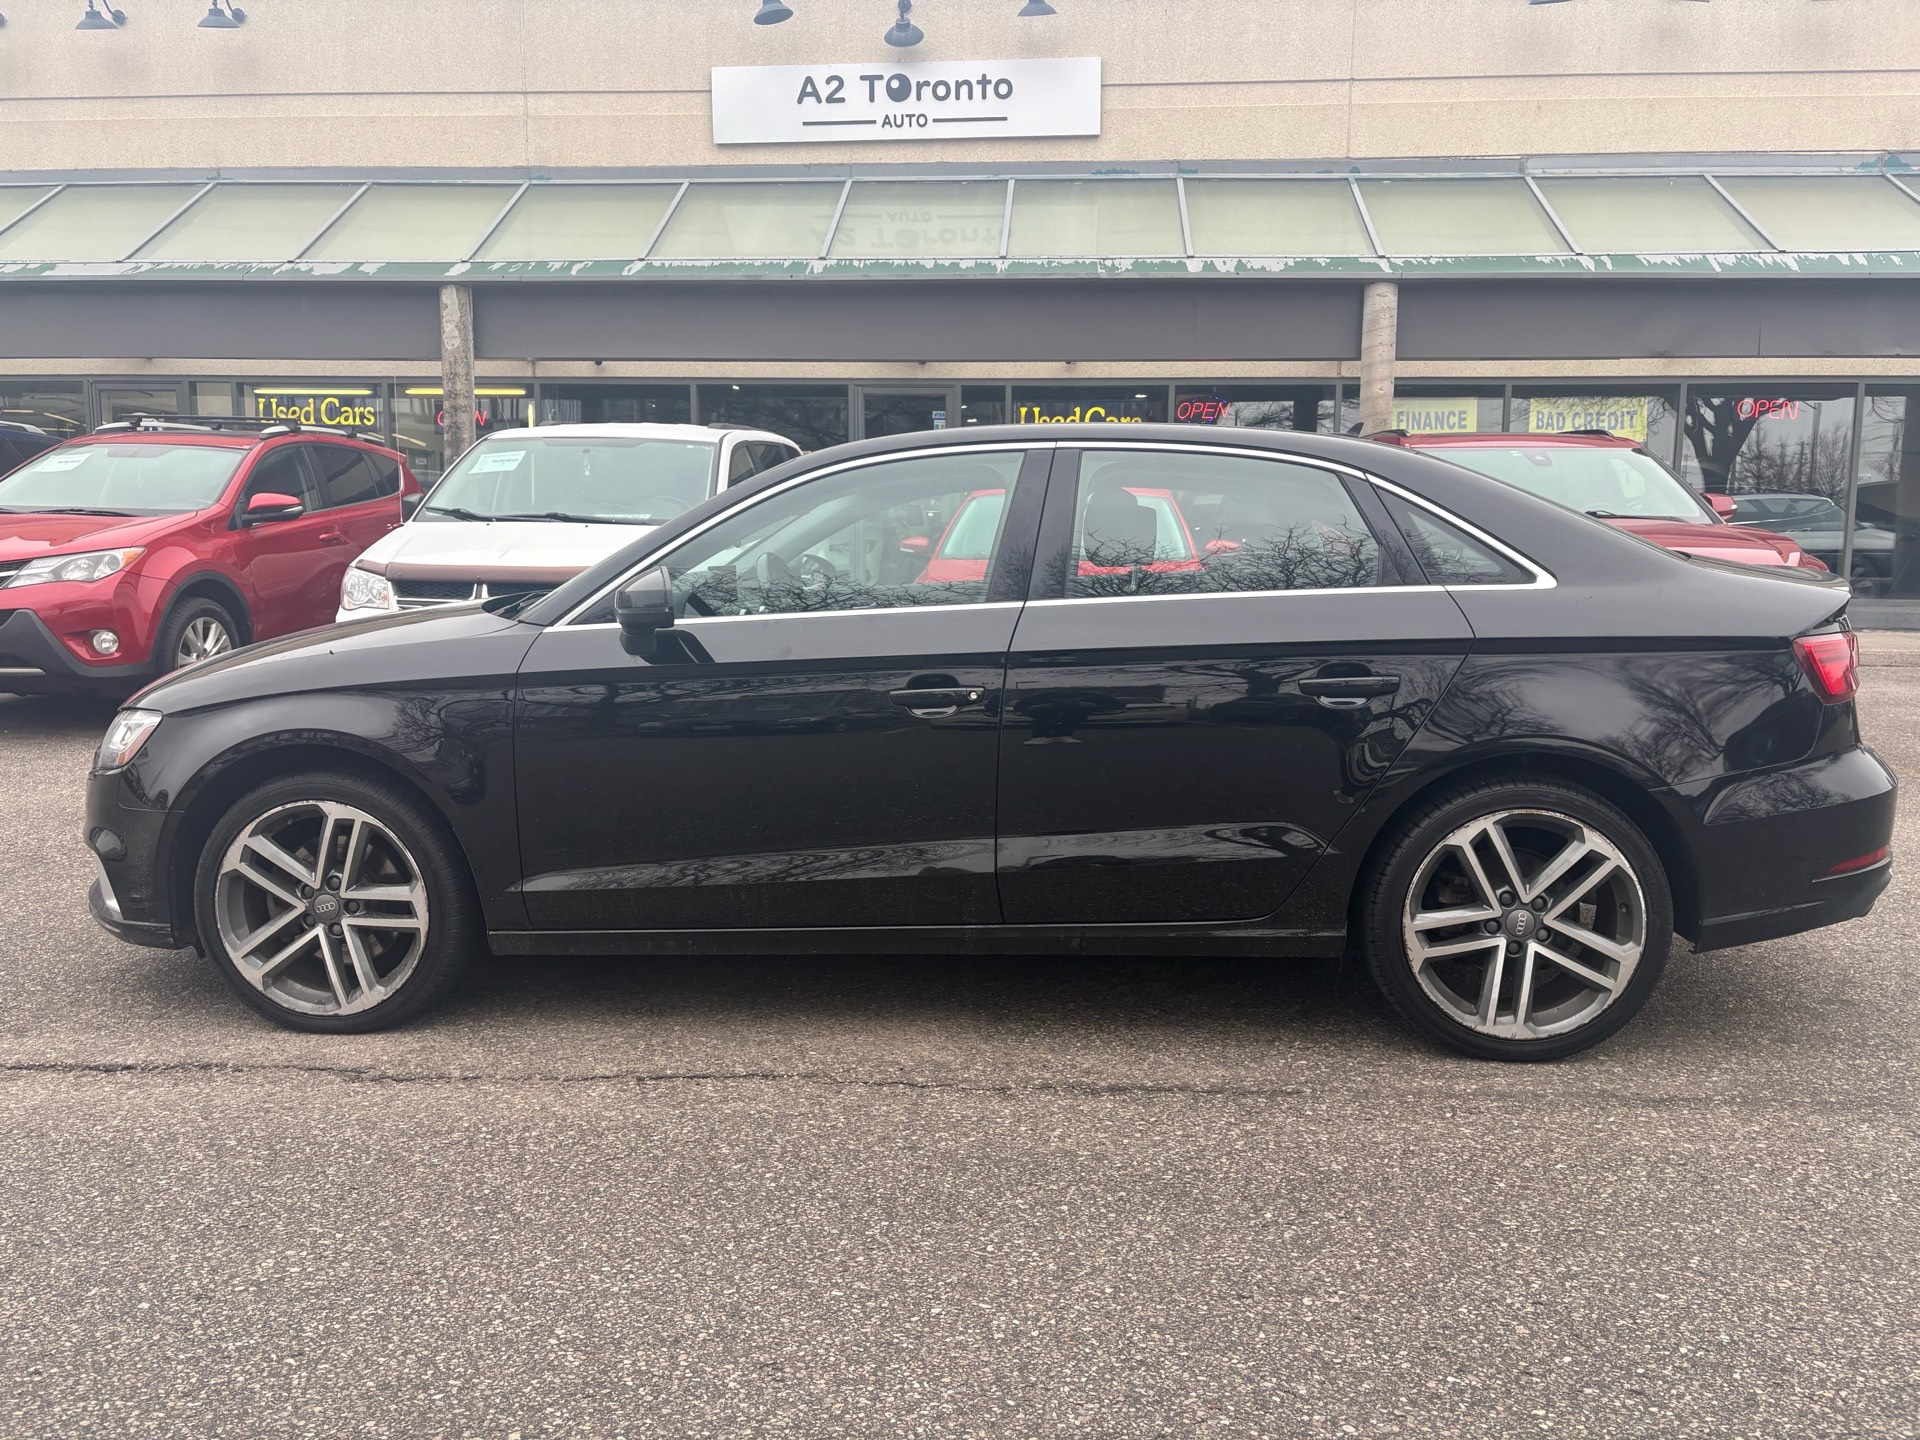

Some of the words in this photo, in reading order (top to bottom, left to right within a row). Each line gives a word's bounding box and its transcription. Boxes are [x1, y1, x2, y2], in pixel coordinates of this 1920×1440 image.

[797, 74, 846, 105] A2
[881, 113, 928, 130] AUTO
[257, 397, 316, 425] Used
[320, 397, 376, 426] Cars
[436, 409, 487, 426] ON
[1177, 402, 1231, 420] OPEN
[1396, 409, 1468, 430] FINANCE
[1736, 399, 1800, 420] OPEN
[1535, 410, 1566, 430] BAD
[1571, 410, 1638, 430] CREDIT
